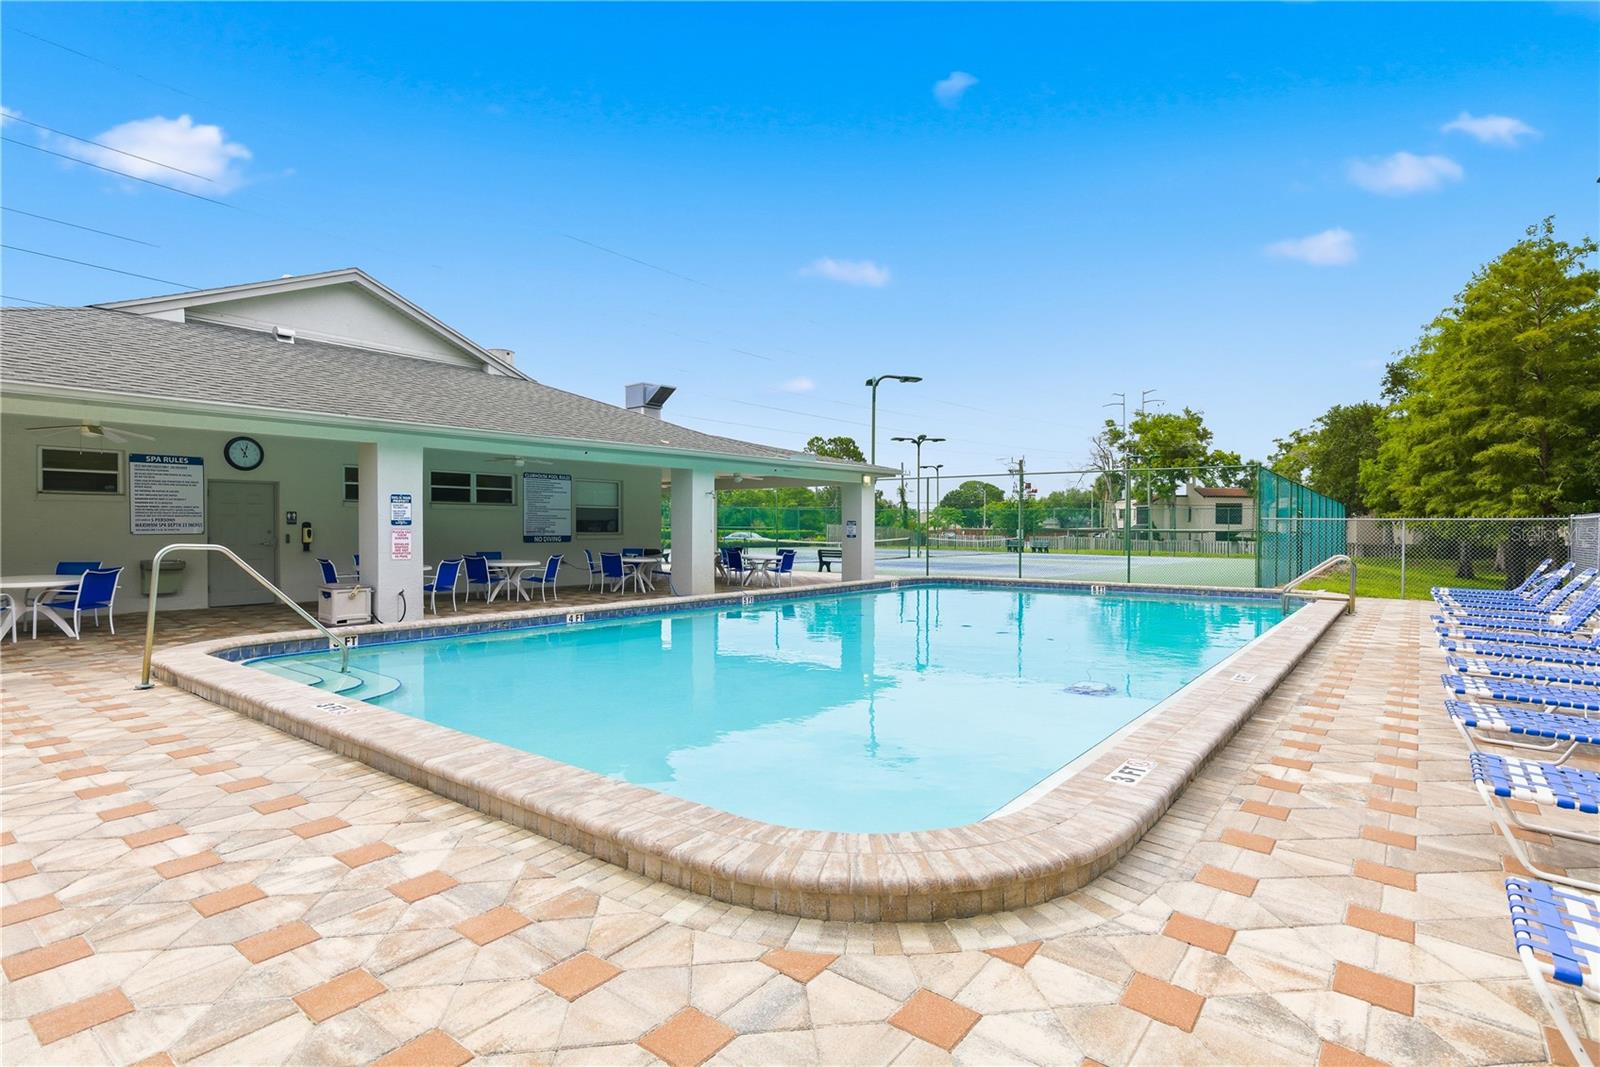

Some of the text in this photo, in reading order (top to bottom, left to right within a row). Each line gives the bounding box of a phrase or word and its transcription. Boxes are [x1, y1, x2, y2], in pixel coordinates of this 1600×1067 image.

[145, 455, 162, 463] SPA
[575, 614, 583, 622] FT
[344, 636, 357, 646] FT
[1110, 765, 1147, 783] 3 FT
